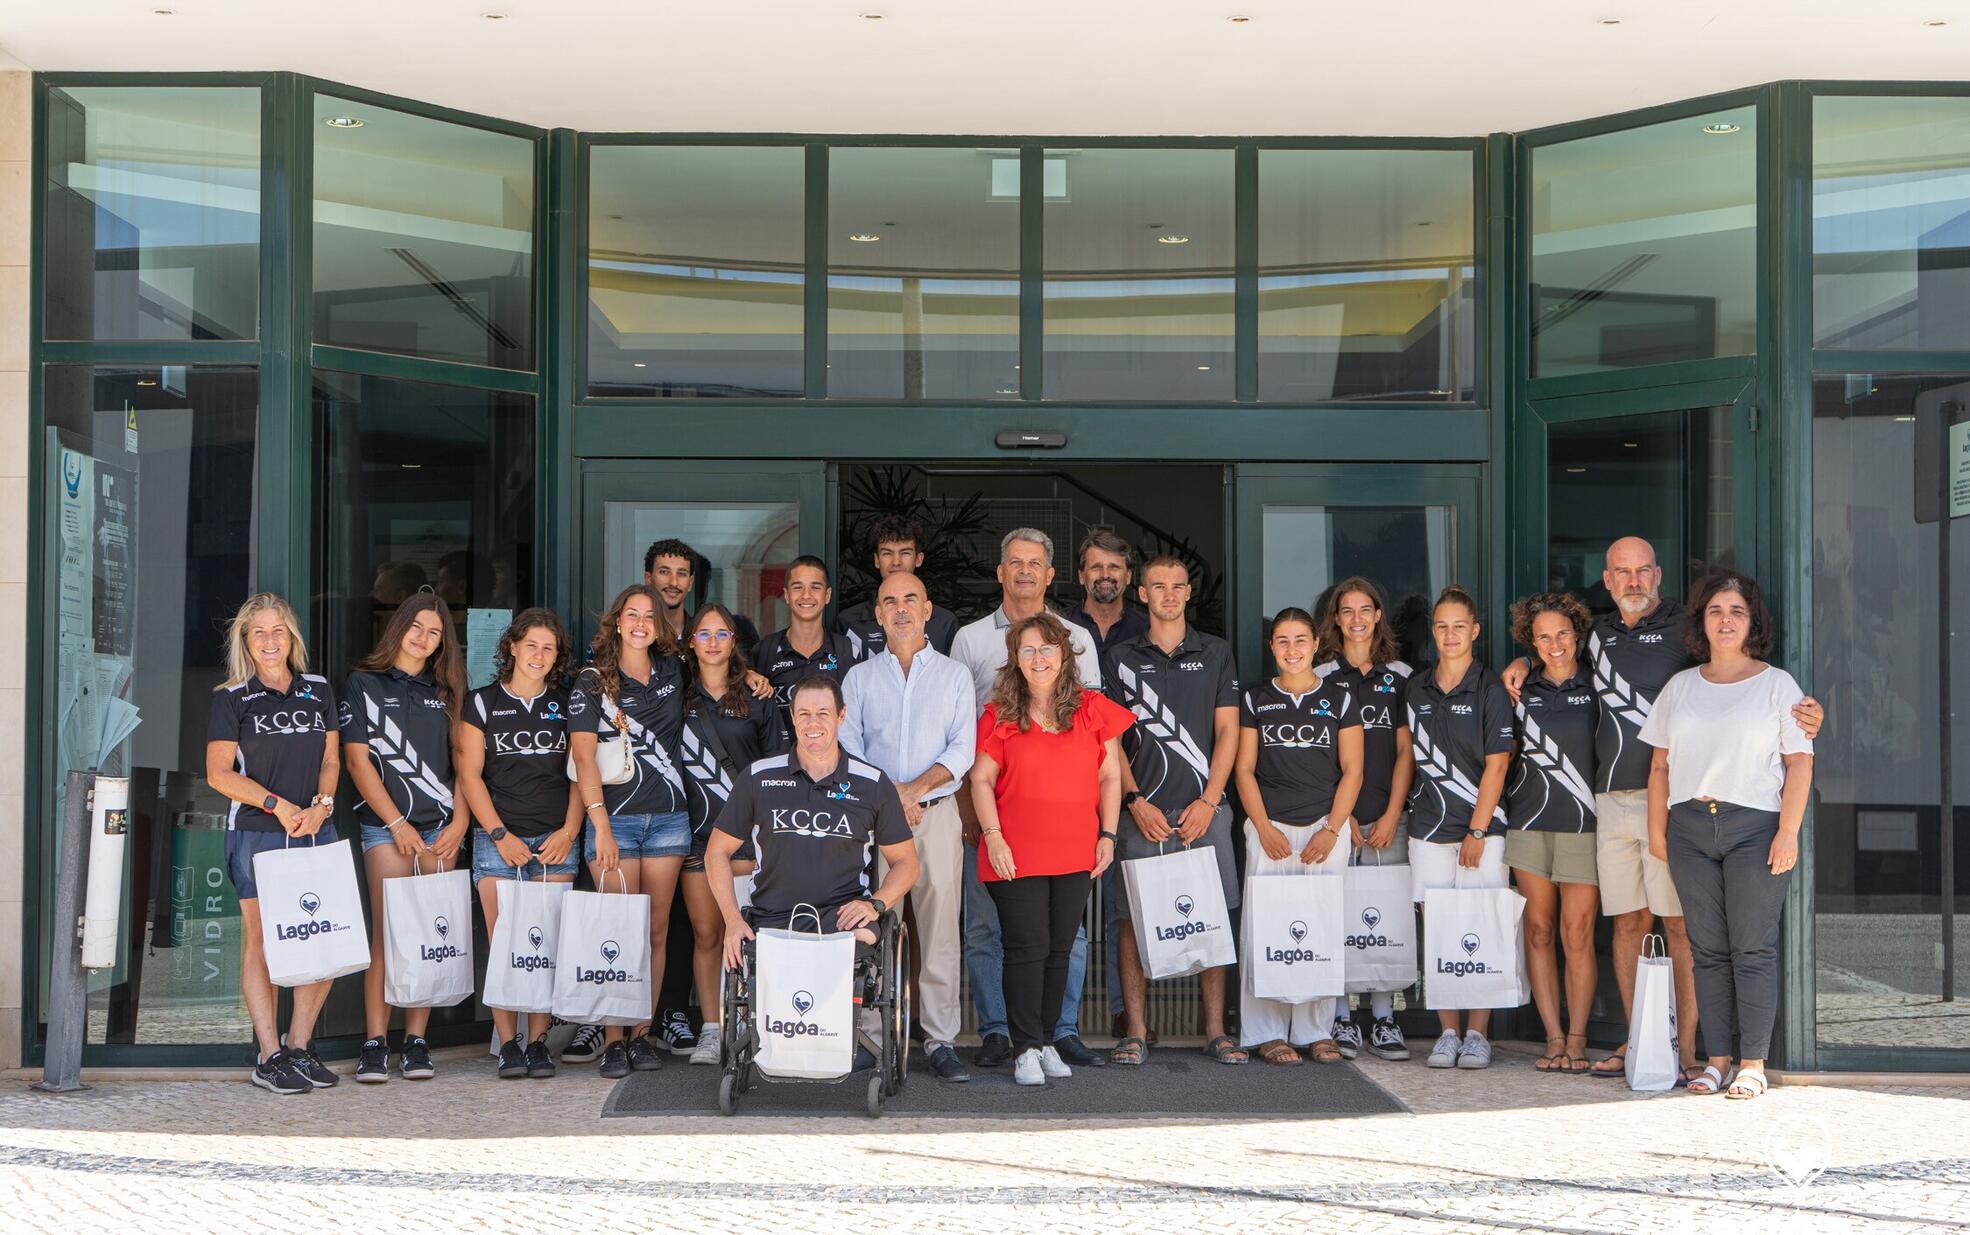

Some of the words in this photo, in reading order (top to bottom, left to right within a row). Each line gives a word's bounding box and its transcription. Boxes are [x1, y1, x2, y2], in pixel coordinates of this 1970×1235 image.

[1638, 633, 1663, 641] KCCA
[1180, 661, 1204, 669] KCCA
[241, 690, 267, 702] macron
[655, 684, 676, 697] KCCA
[1567, 695, 1592, 704] KCCA
[423, 698, 447, 706] KCCA
[1257, 702, 1287, 713] macron
[1450, 703, 1473, 713] KCCA
[492, 708, 517, 717] macron
[253, 710, 326, 735] KCCA
[493, 730, 567, 752] KCCA
[1261, 724, 1332, 745] KCCA
[761, 779, 797, 788] macron
[826, 789, 852, 801] Lagoa
[771, 808, 854, 835] KCCA
[203, 866, 224, 983] VIDRO
[276, 919, 333, 942] Lagoa
[1155, 920, 1206, 942] Lagoa
[1344, 933, 1387, 949] agoa
[420, 944, 457, 963] Lagoa
[511, 952, 550, 973] Lagoa
[1265, 946, 1314, 966] Lagoa
[576, 966, 627, 985] Lagoa
[1437, 957, 1486, 978] Lagoa
[765, 1014, 819, 1039] Lagoa
